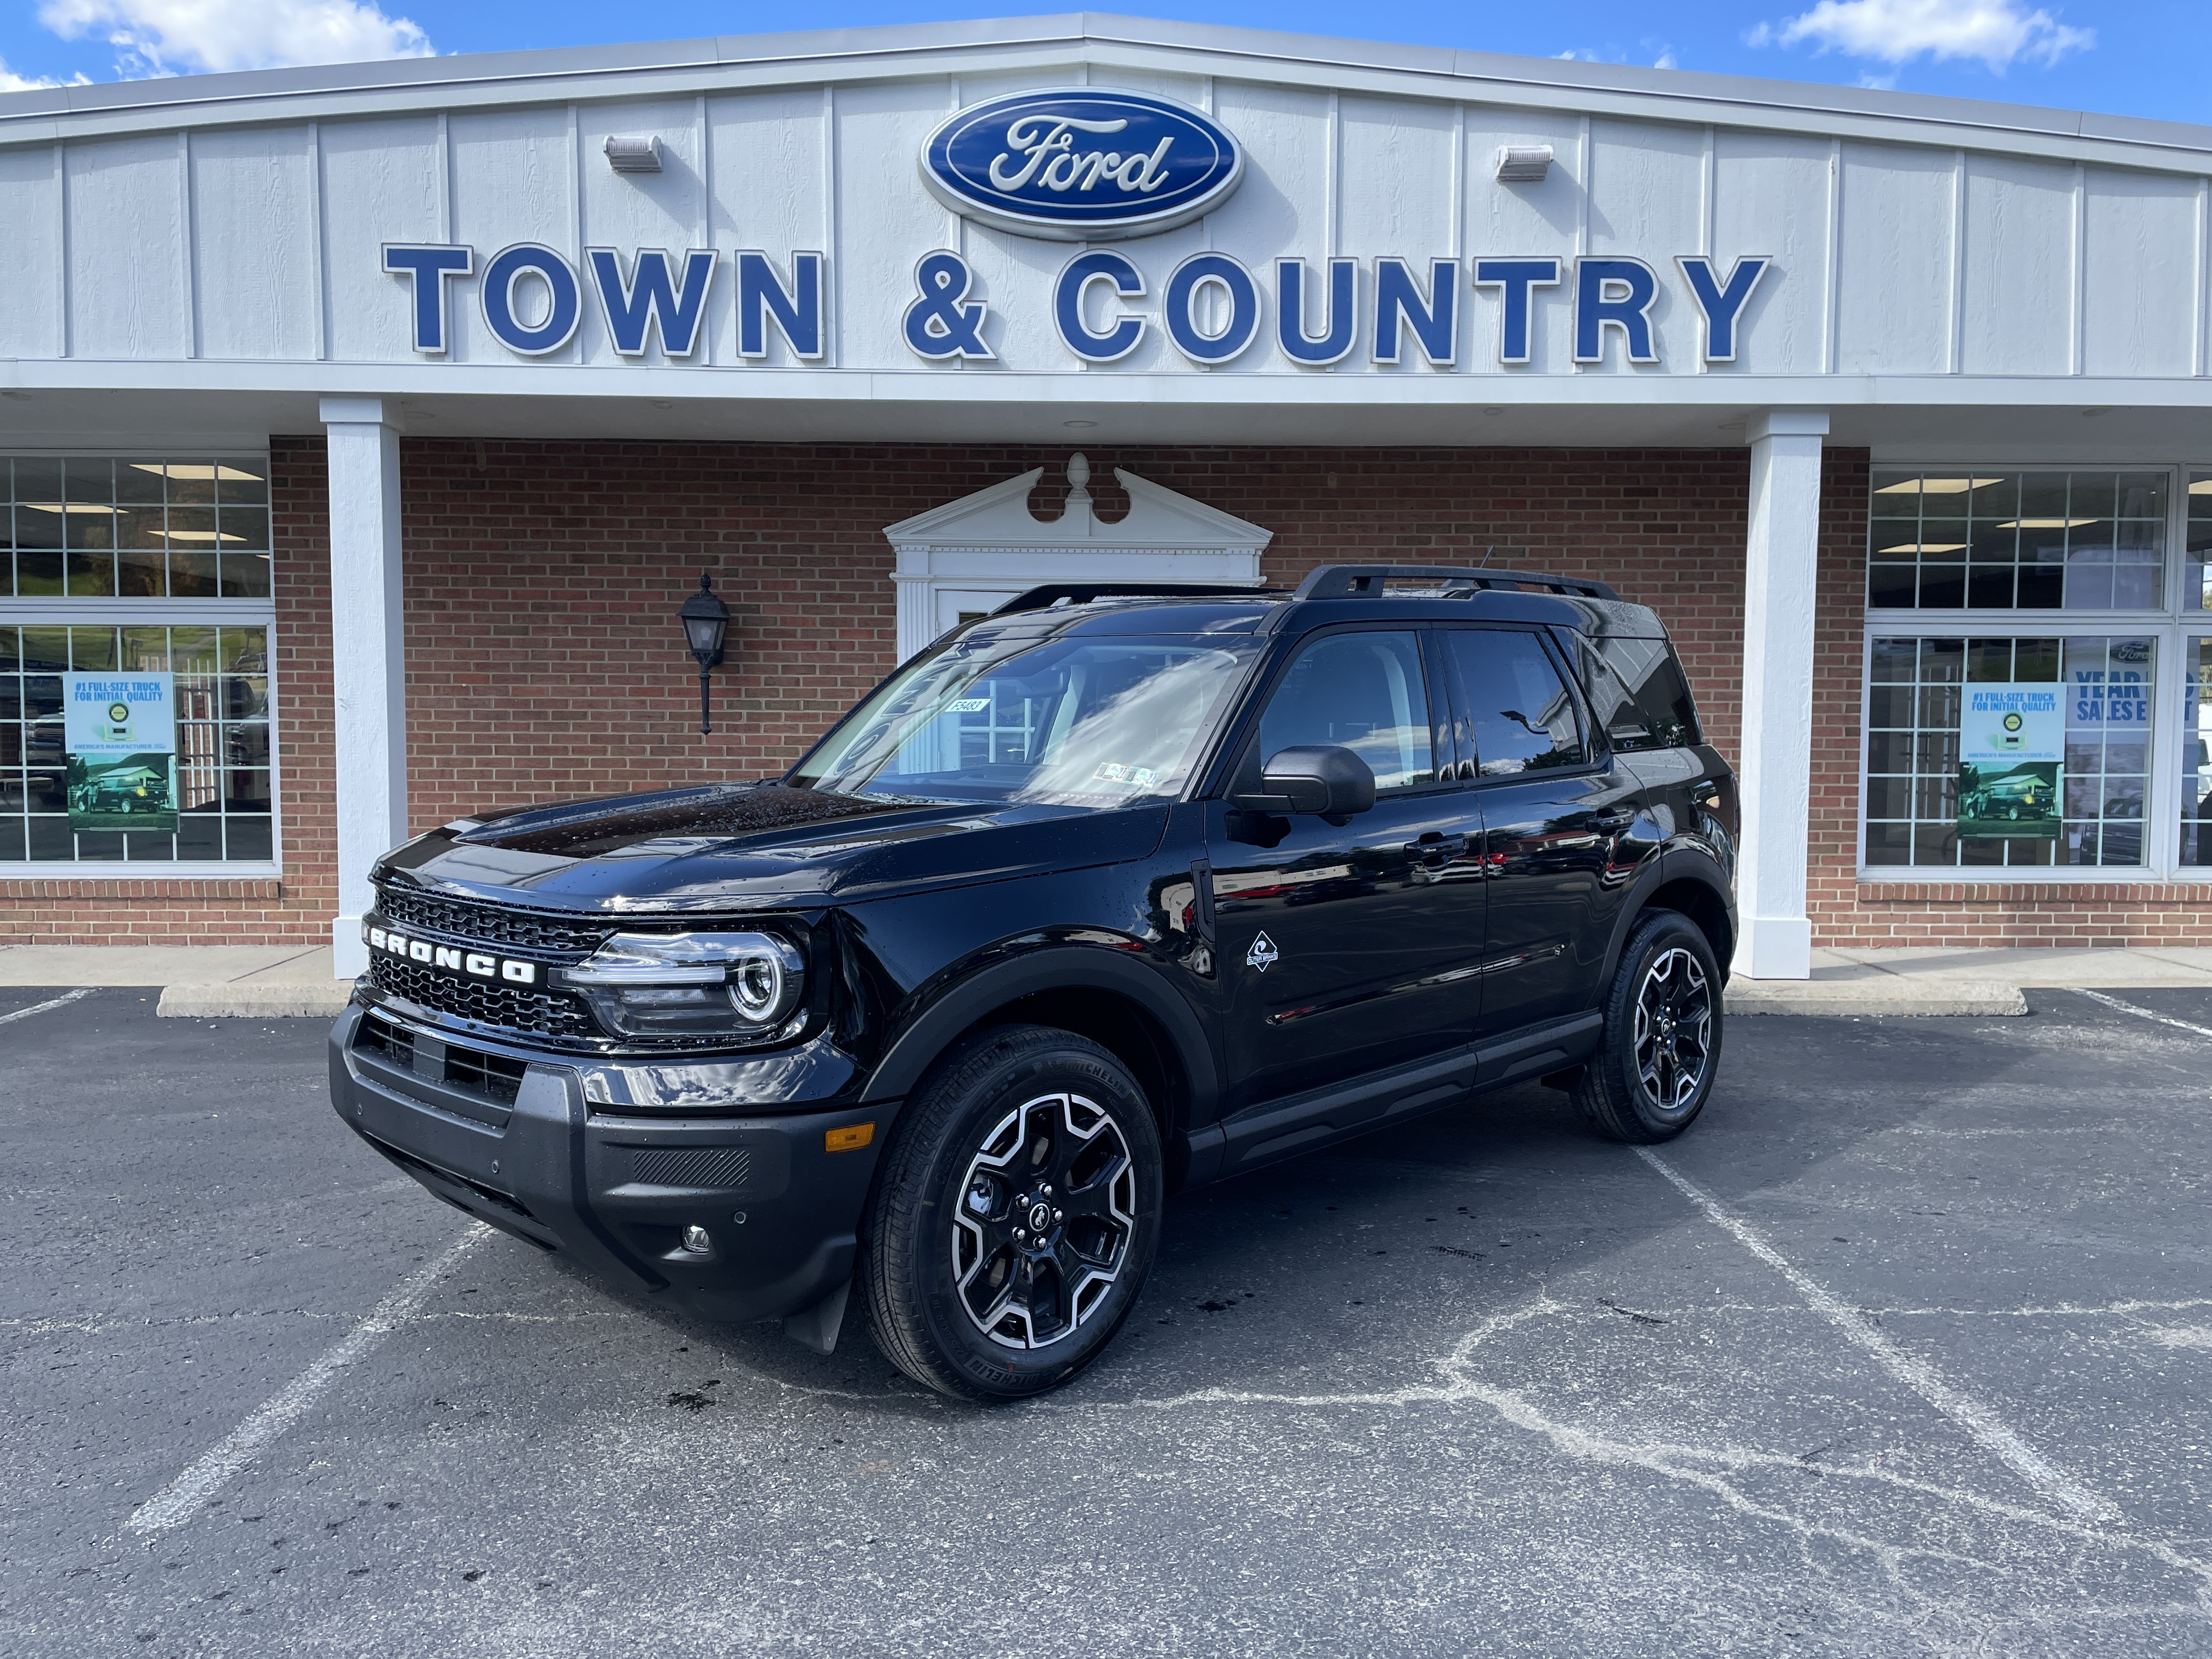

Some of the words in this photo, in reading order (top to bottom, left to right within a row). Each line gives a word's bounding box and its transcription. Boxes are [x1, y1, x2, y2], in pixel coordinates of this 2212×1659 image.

[989, 114, 1175, 193] Ford
[382, 242, 824, 360] TOWN
[901, 248, 998, 360] &
[1052, 248, 1774, 365] COUNTRY
[75, 692, 92, 701] FOR
[94, 692, 125, 701] INITIAL
[127, 692, 163, 703] QUALITY
[76, 682, 86, 691] #1
[88, 682, 129, 691] FULL-SIZE
[132, 682, 160, 691] TRUCK
[1973, 692, 1983, 702] #1
[1985, 692, 2024, 702] FULL-SIZE
[2027, 692, 2054, 702] TRUCK
[2075, 671, 2141, 698] YEAR
[950, 701, 982, 711] F5483
[1972, 702, 1988, 711] FOR
[1990, 702, 2019, 711] INITIAL
[2022, 702, 2056, 713] QUALITY
[370, 927, 535, 983] BRONCO
[1067, 1059, 1127, 1095] MICHELIN
[1133, 1099, 1154, 1139] PRIMACY
[969, 1359, 1041, 1386] MICHELIN
